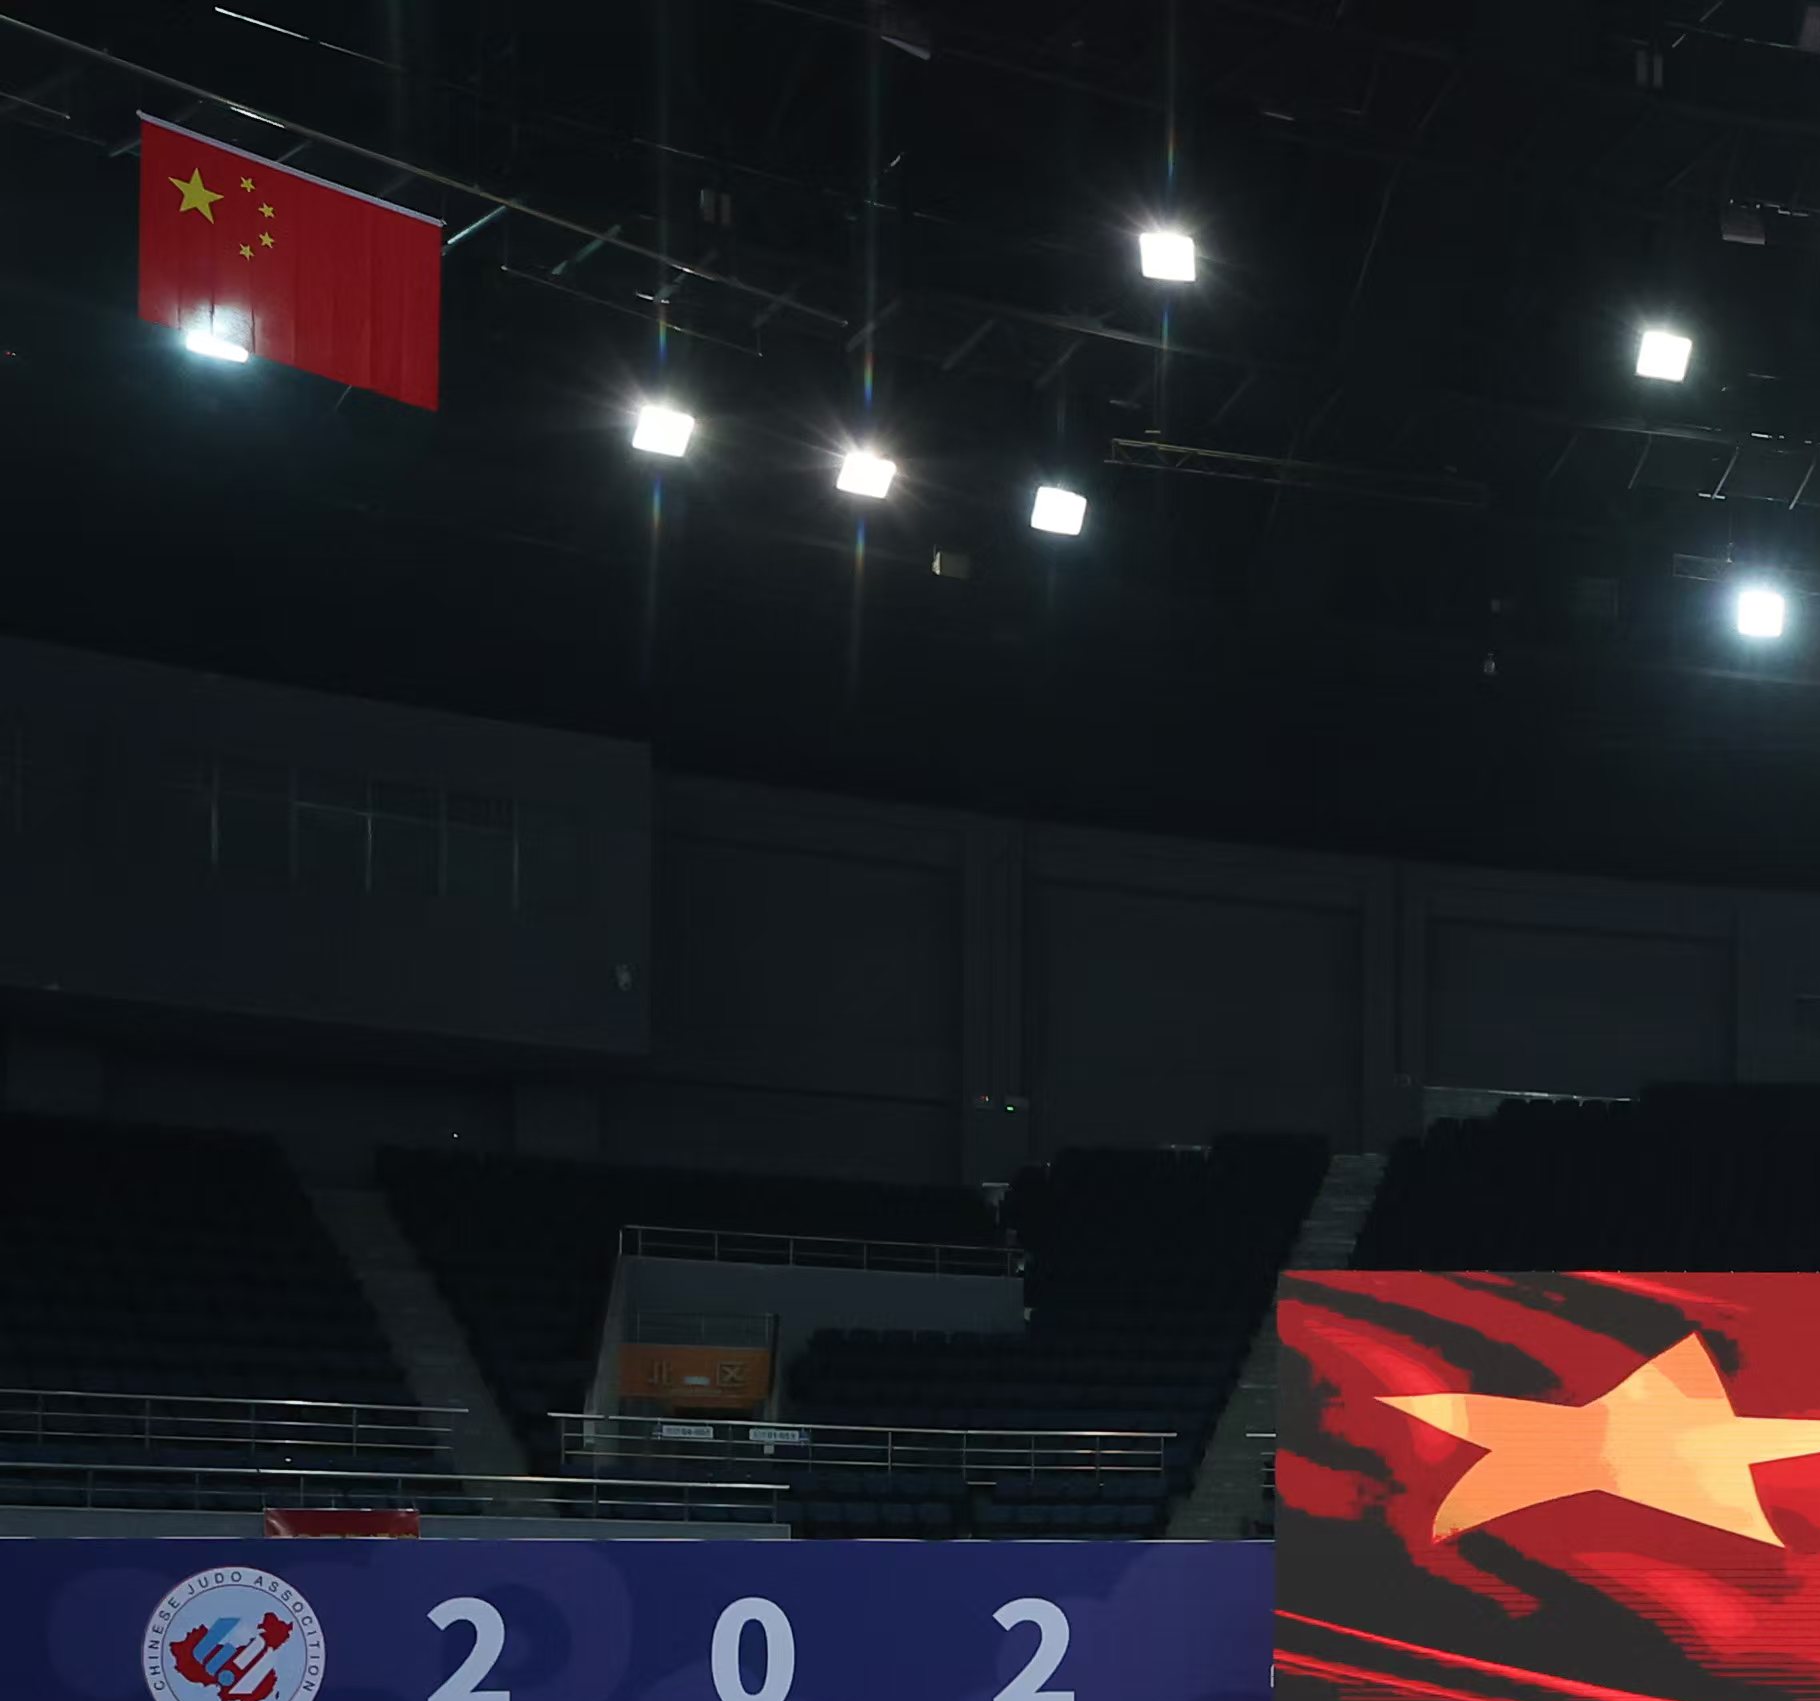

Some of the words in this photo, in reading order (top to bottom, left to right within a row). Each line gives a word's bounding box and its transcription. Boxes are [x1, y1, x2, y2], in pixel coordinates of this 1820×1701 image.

[149, 1597, 180, 1691] CHINESE
[187, 1571, 242, 1595] JUDO
[254, 1575, 321, 1692] ASSOCITION
